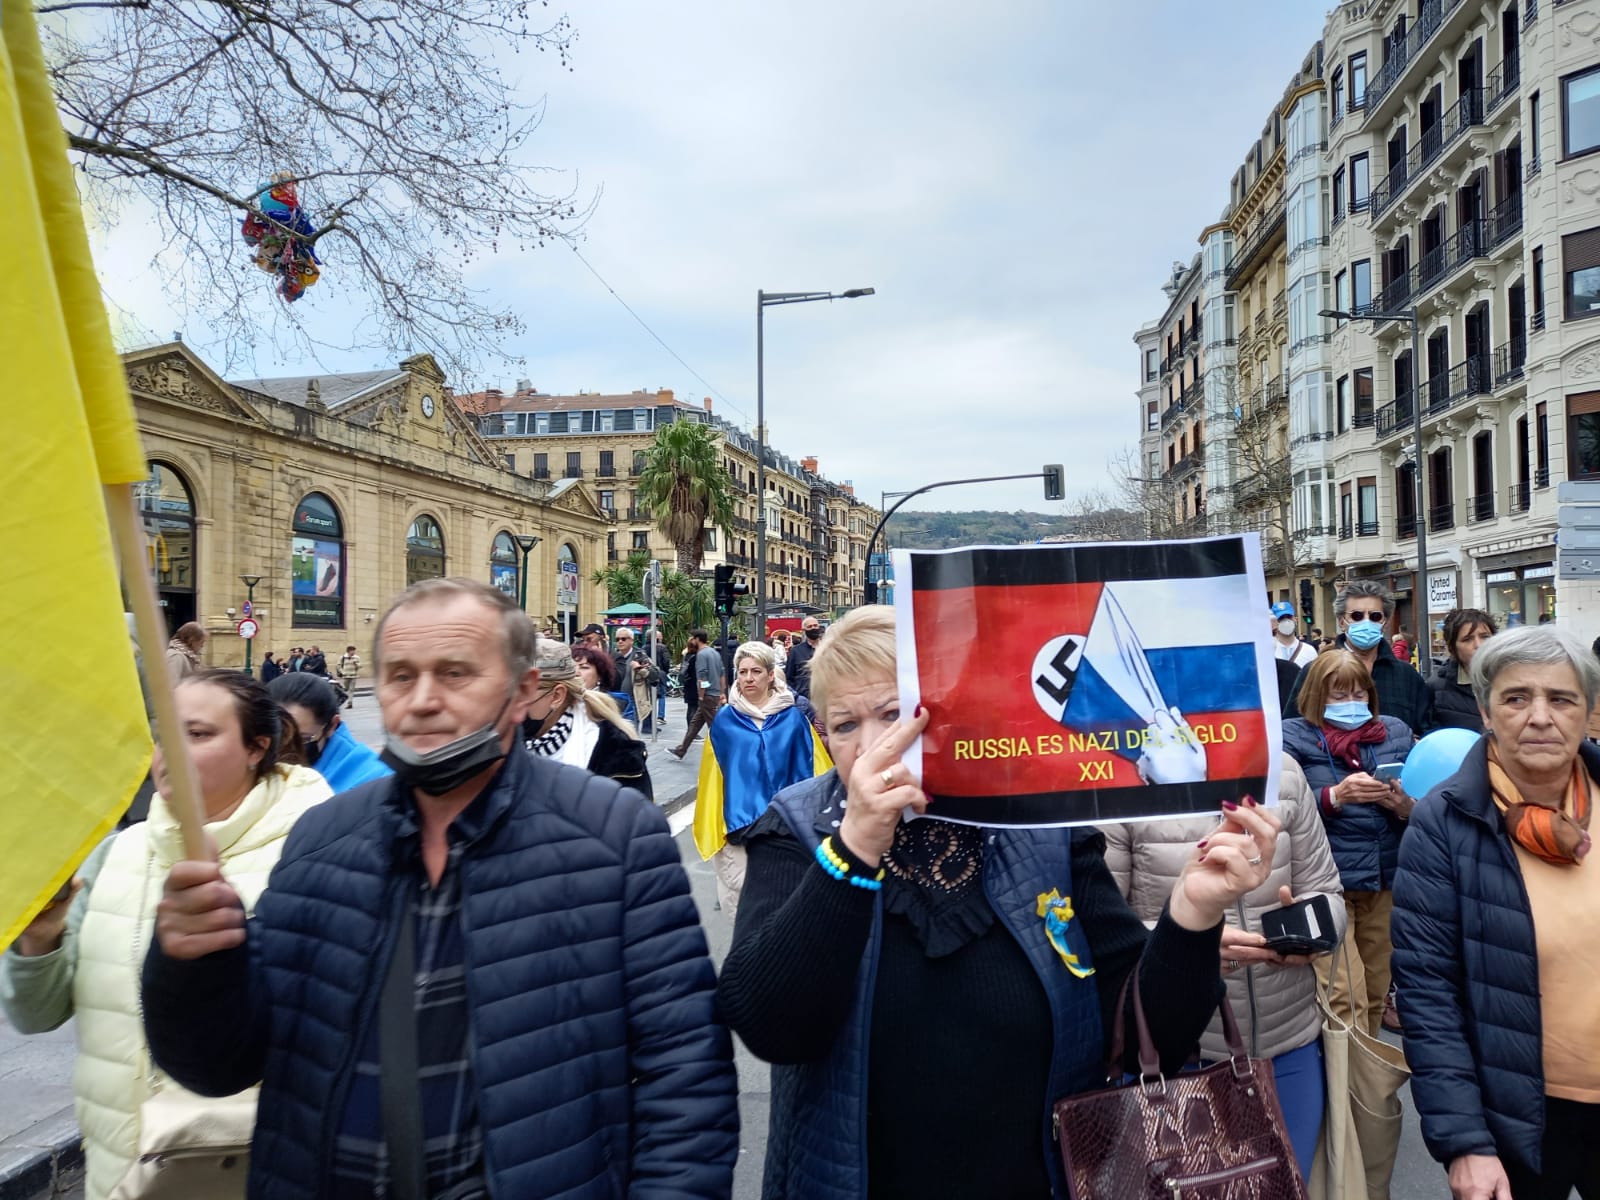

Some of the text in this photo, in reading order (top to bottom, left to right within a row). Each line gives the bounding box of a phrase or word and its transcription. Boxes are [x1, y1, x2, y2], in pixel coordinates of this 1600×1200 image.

[1431, 574, 1450, 589] United
[954, 737, 1033, 761] RUSSIA
[1036, 734, 1064, 756] ES
[1068, 730, 1120, 754] NAZI
[1172, 722, 1238, 746] SIGLO
[1078, 760, 1114, 783] XXI
